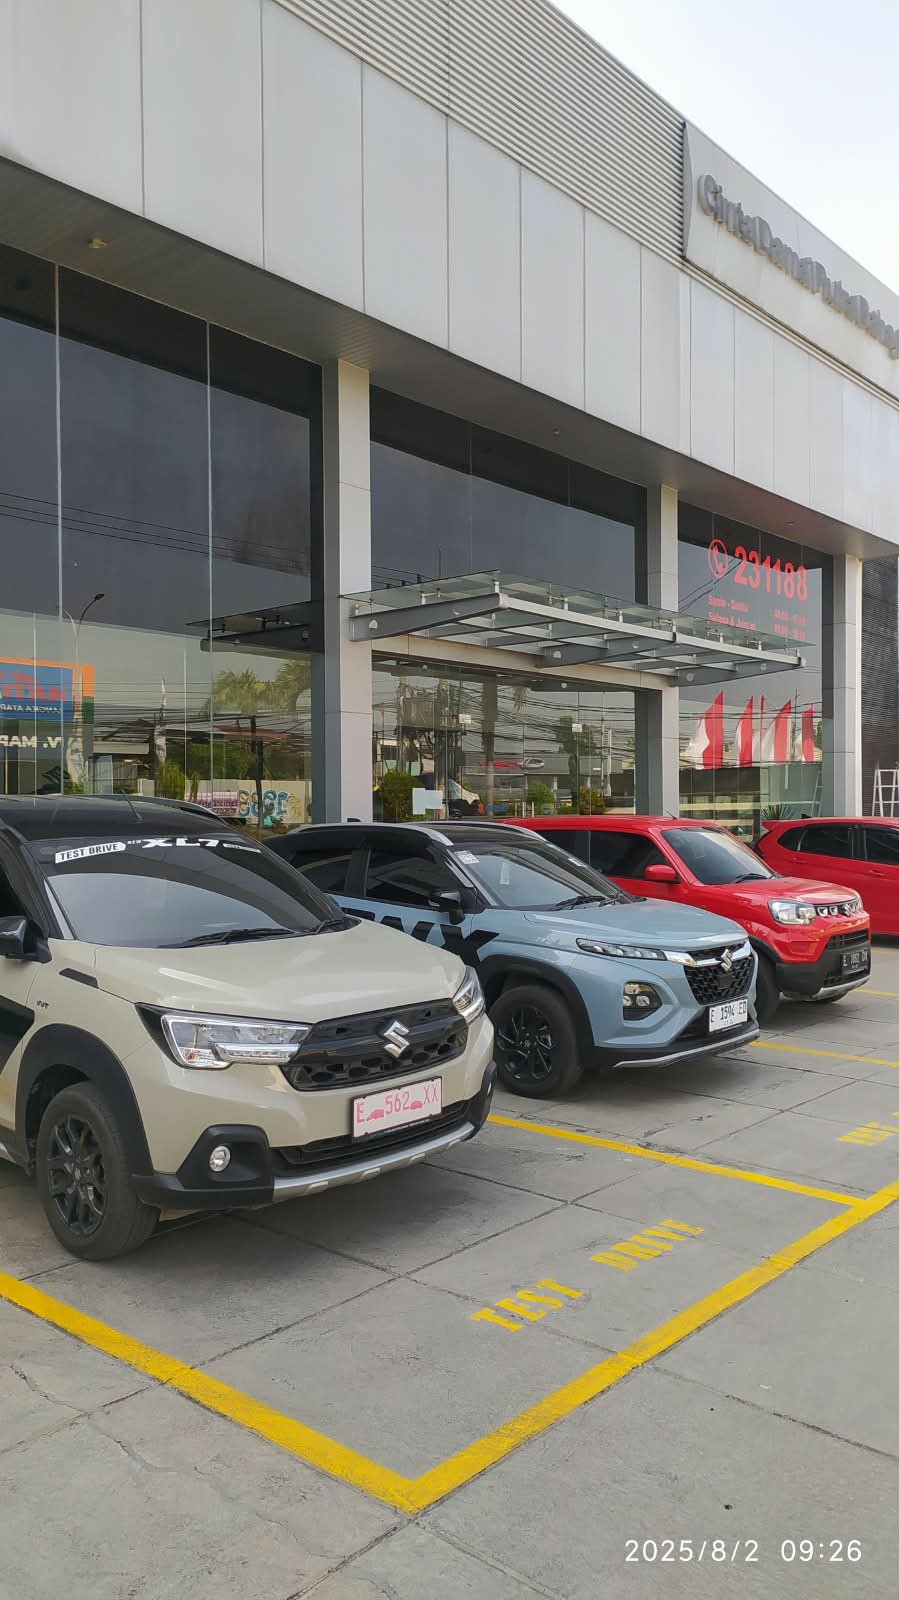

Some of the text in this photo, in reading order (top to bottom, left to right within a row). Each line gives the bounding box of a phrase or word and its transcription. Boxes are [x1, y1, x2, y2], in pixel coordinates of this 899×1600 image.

[735, 546, 808, 602] 231188
[60, 843, 119, 861] TEST DRIVE
[142, 838, 219, 848] XL7
[711, 1009, 715, 1022] E
[720, 1004, 735, 1020] 1594
[739, 1000, 747, 1014] ED
[356, 1083, 439, 1124] E 562 XX
[470, 1219, 705, 1332] TEST DRIVE
